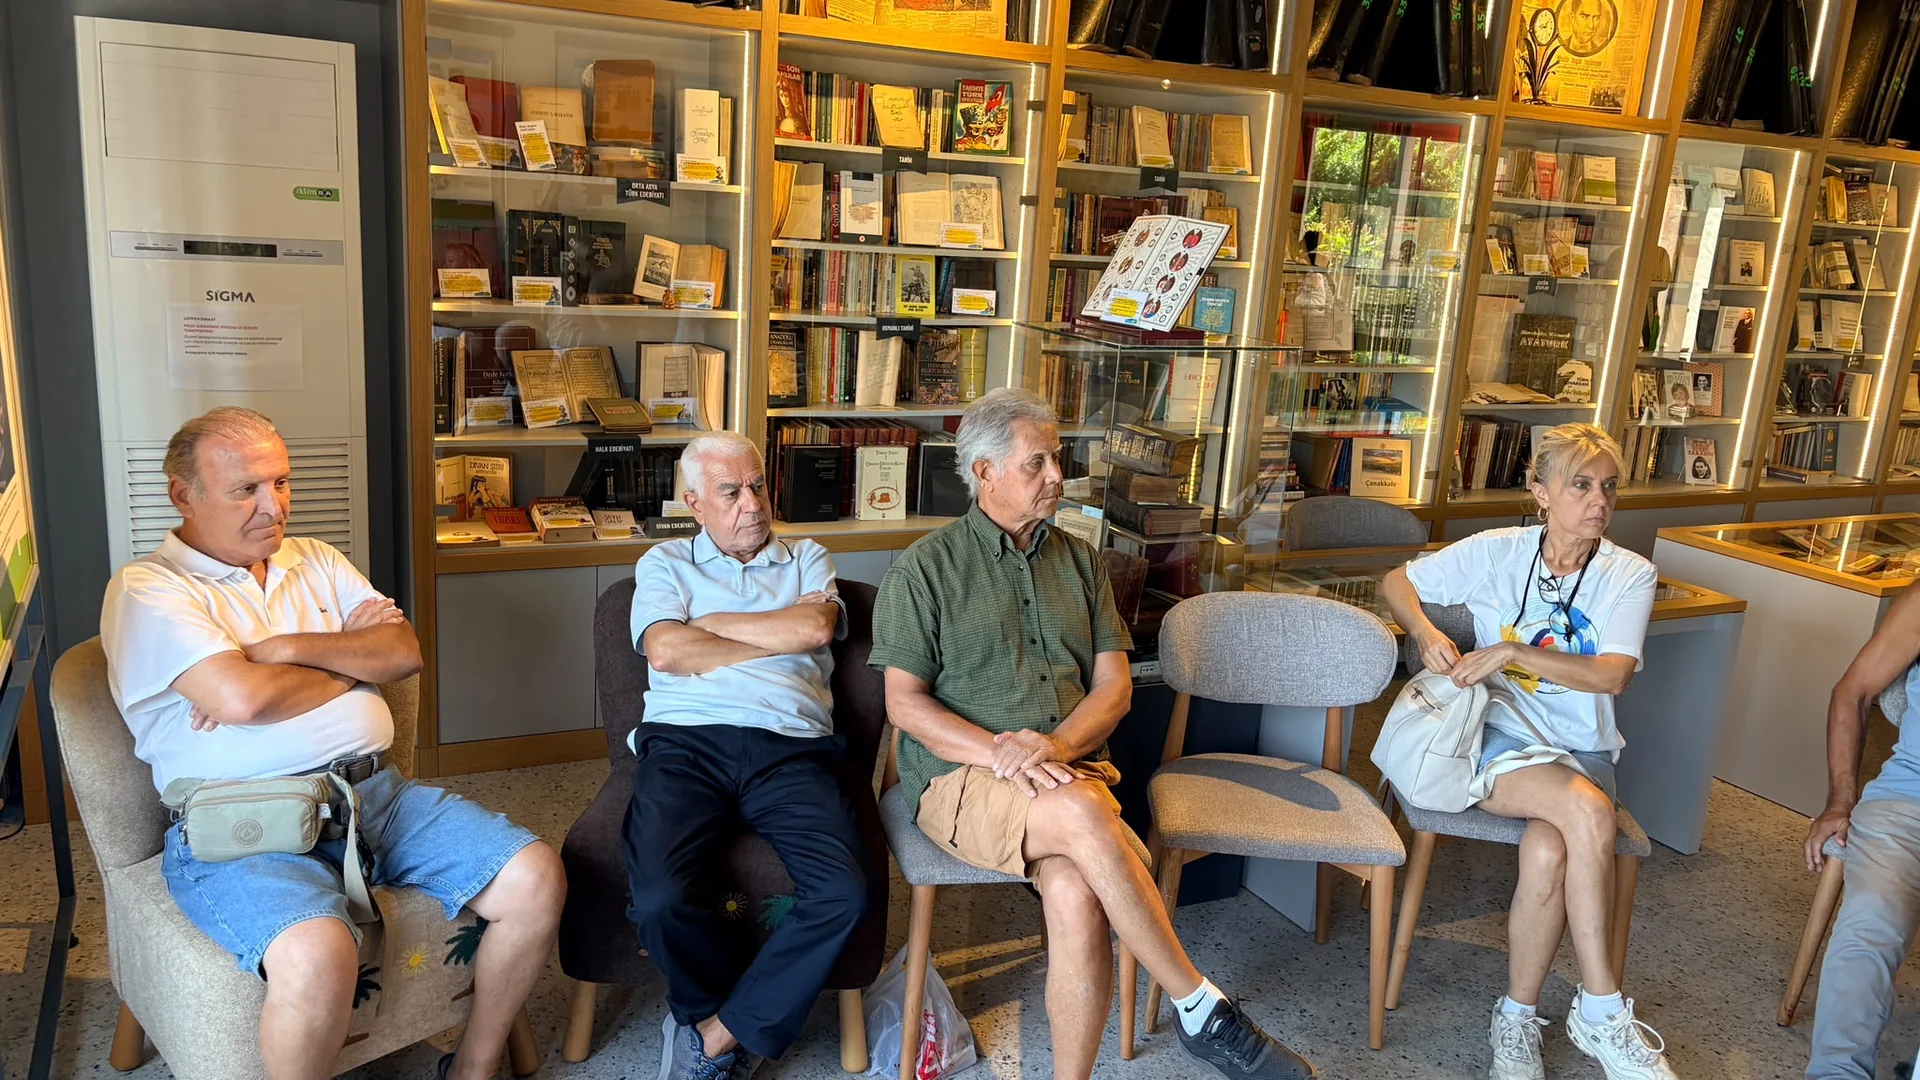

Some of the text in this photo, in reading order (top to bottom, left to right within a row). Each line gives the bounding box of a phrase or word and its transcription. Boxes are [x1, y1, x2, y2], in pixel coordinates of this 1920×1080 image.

[631, 182, 645, 190] ORTA
[625, 189, 665, 199] TÜRK EDEBİYATI
[609, 443, 634, 453] EDEBİYATI
[1365, 479, 1397, 488] Çanakkale
[655, 521, 696, 530] DİVAN EDEBİYATI
